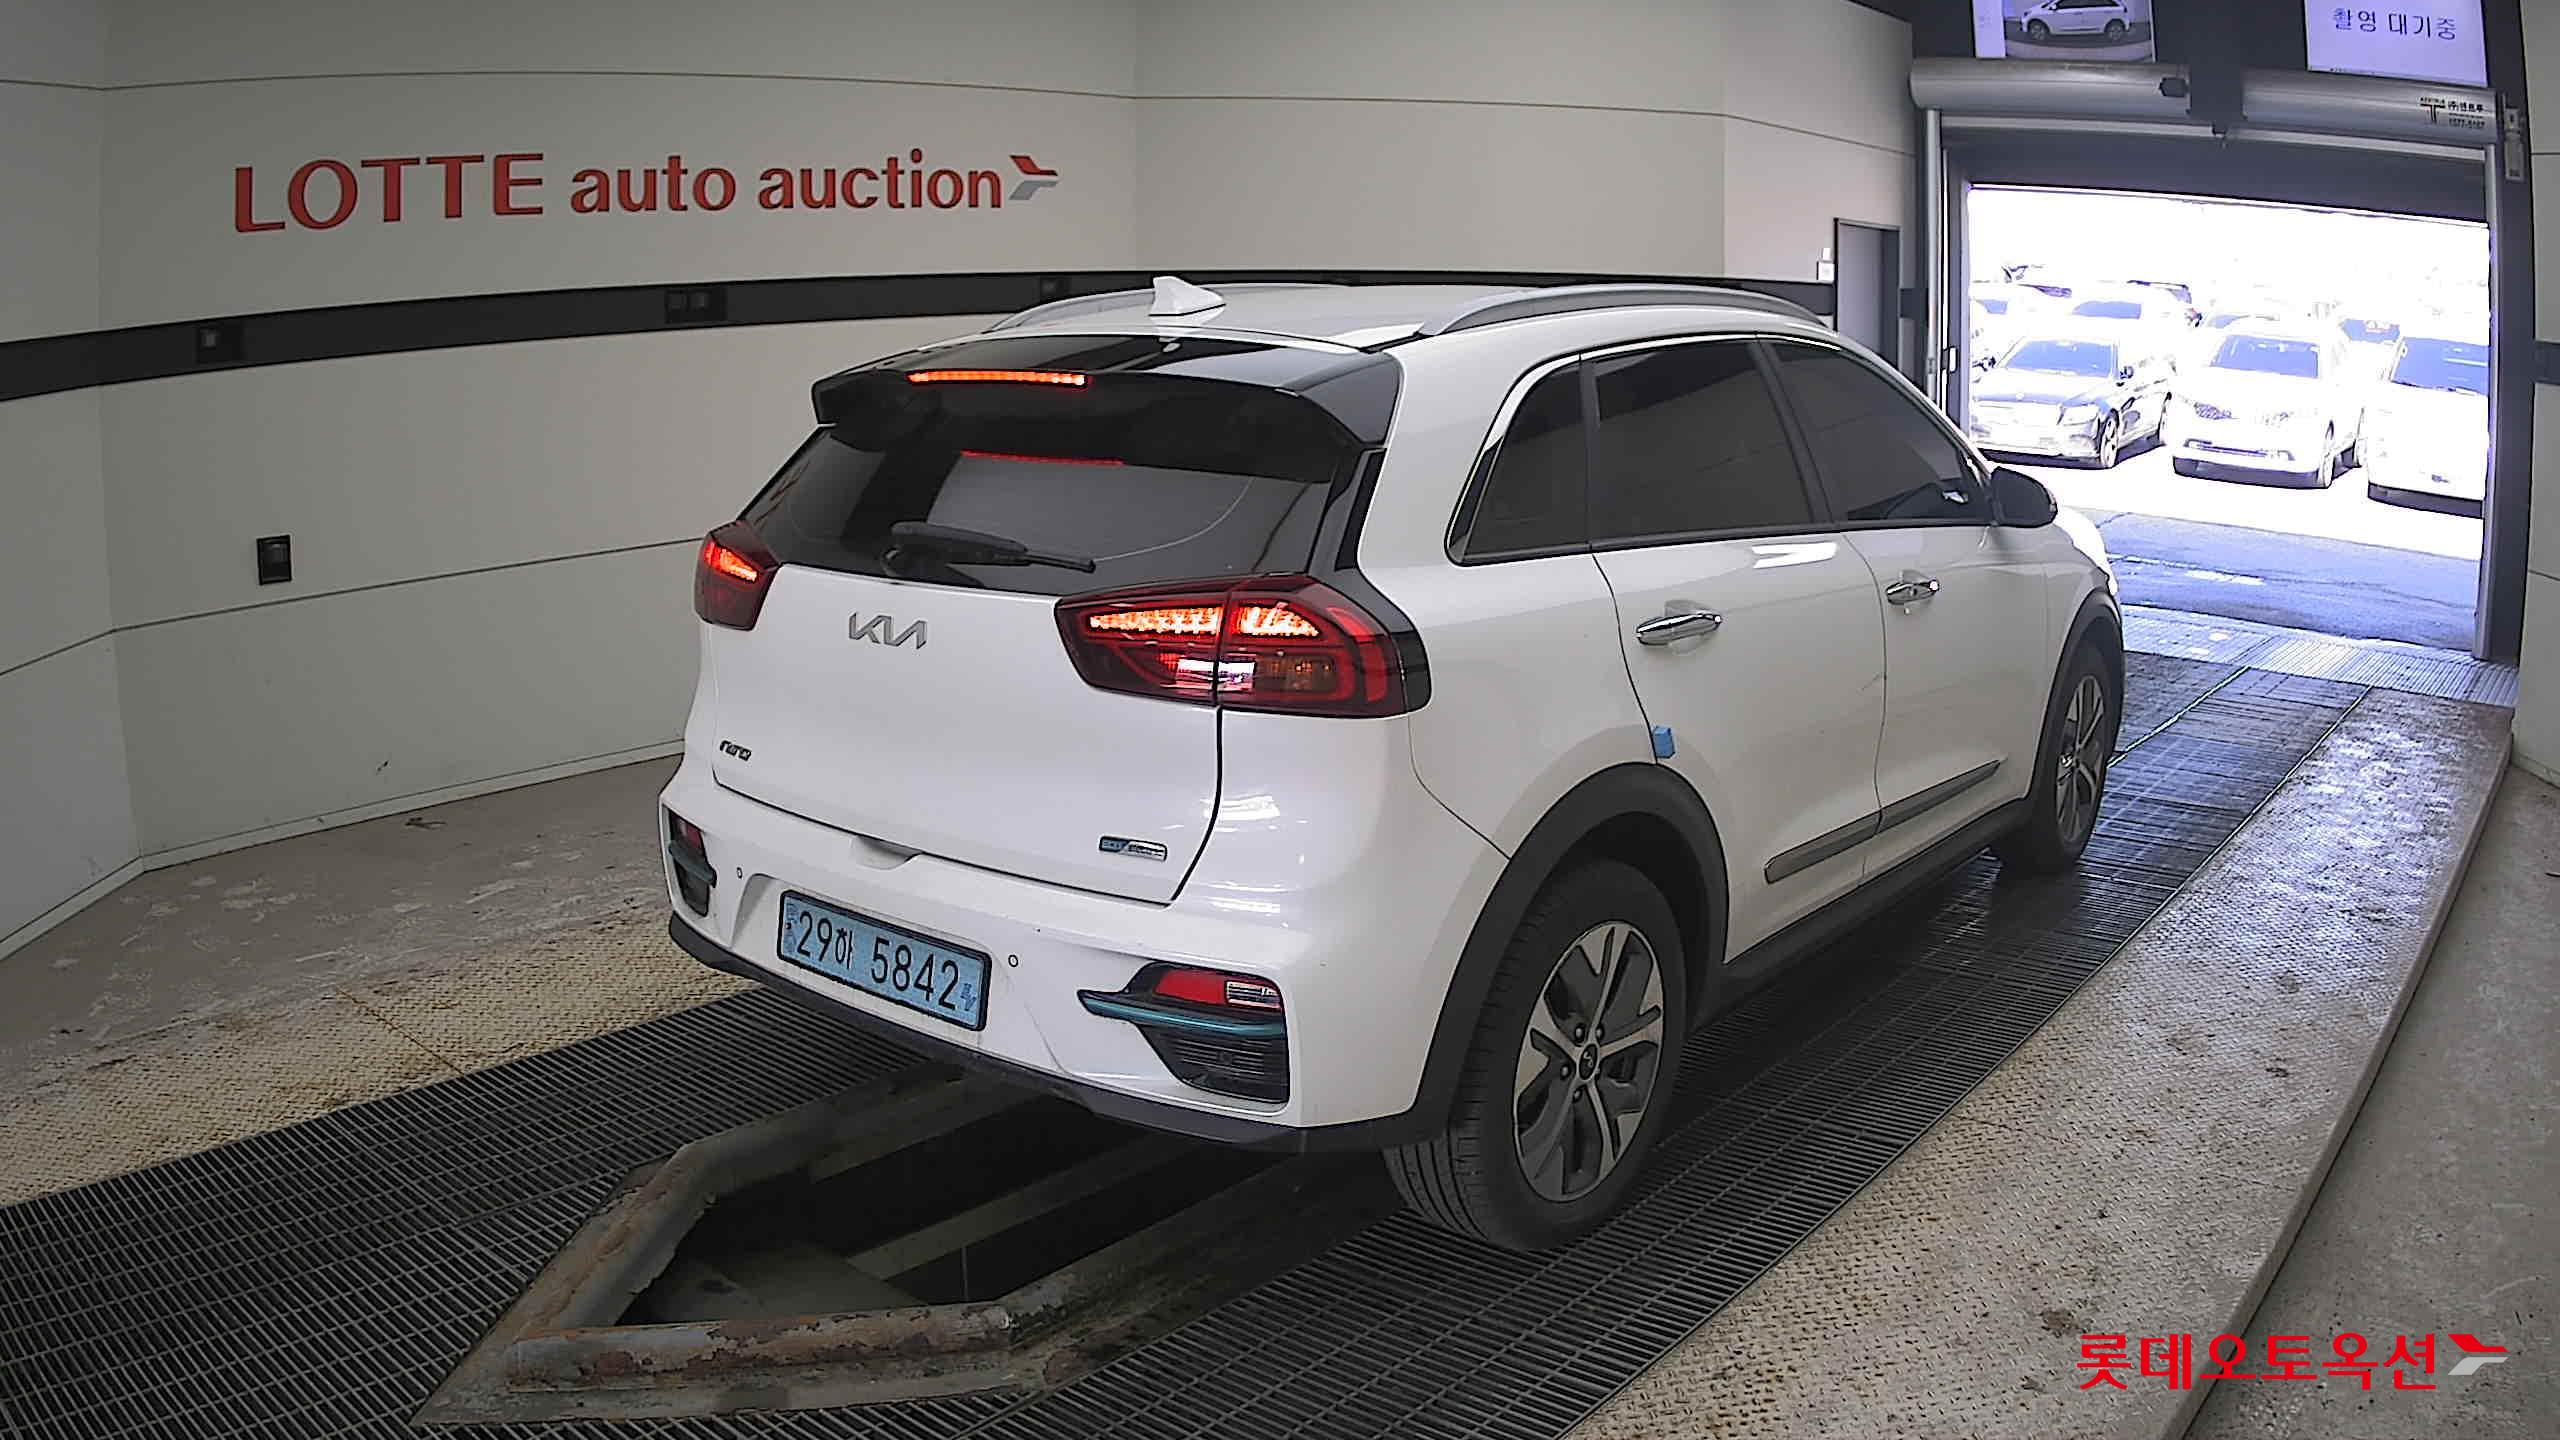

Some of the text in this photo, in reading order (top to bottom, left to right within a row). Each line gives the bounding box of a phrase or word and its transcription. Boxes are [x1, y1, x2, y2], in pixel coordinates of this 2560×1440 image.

[2388, 13, 2457, 41] 대기중
[235, 147, 1002, 233] LOTTE auto auction
[848, 612, 928, 650] KIA
[796, 911, 854, 970] 29하
[870, 937, 960, 1011] 5842
